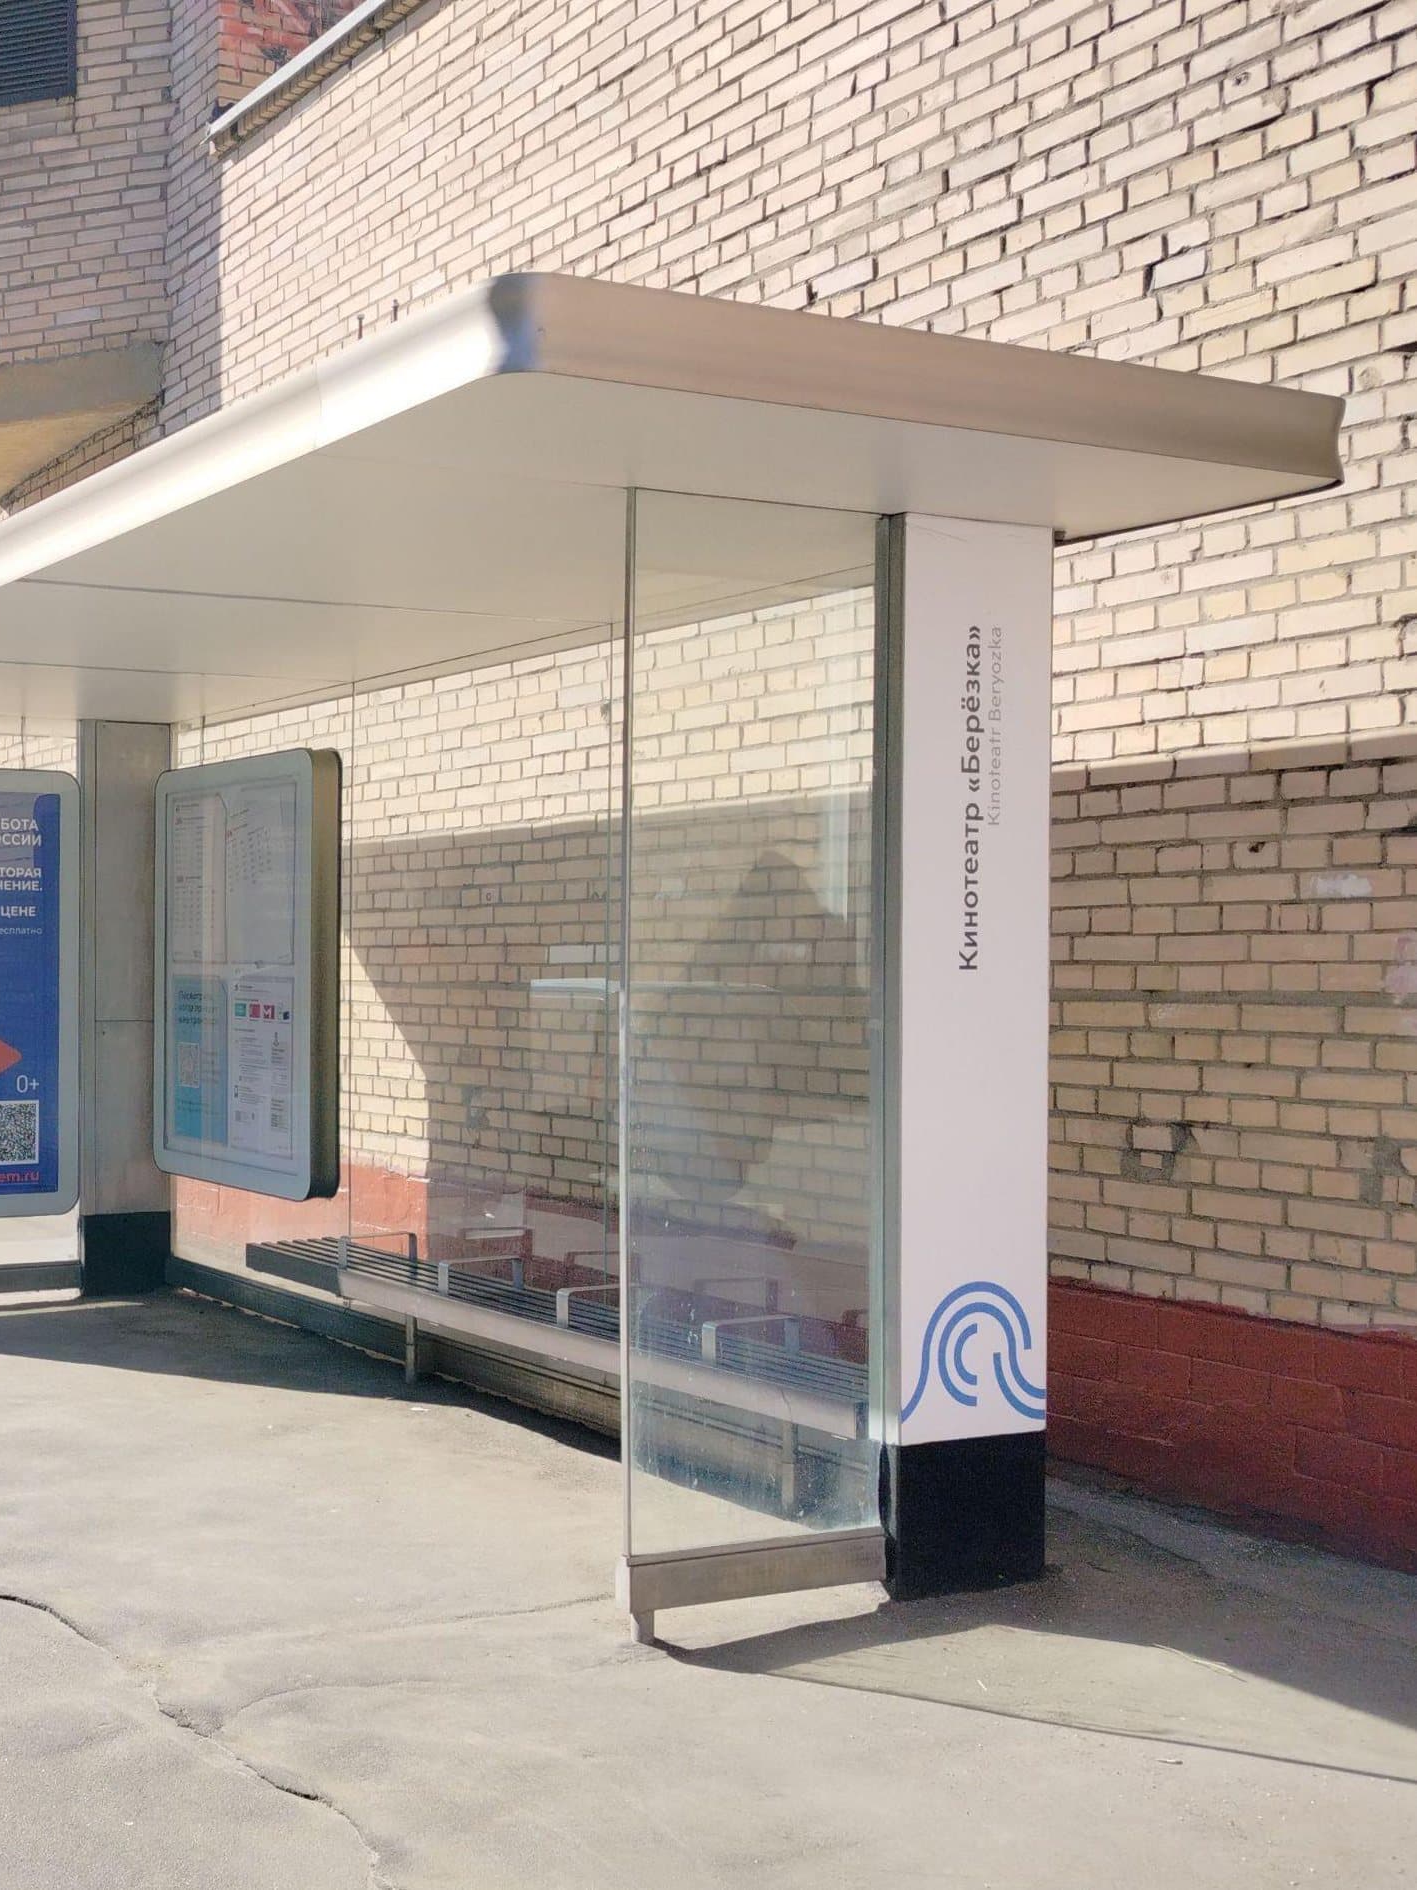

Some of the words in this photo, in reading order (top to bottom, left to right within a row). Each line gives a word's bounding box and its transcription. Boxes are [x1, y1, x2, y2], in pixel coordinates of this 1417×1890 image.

[960, 624, 984, 793] «Берёзка»
[987, 626, 1003, 721] Beryozka
[987, 727, 1002, 826] Kinoteatr
[1, 906, 36, 918] ЦЕНЕ
[958, 801, 983, 970] Кинотеатр
[17, 1075, 40, 1093] 0+
